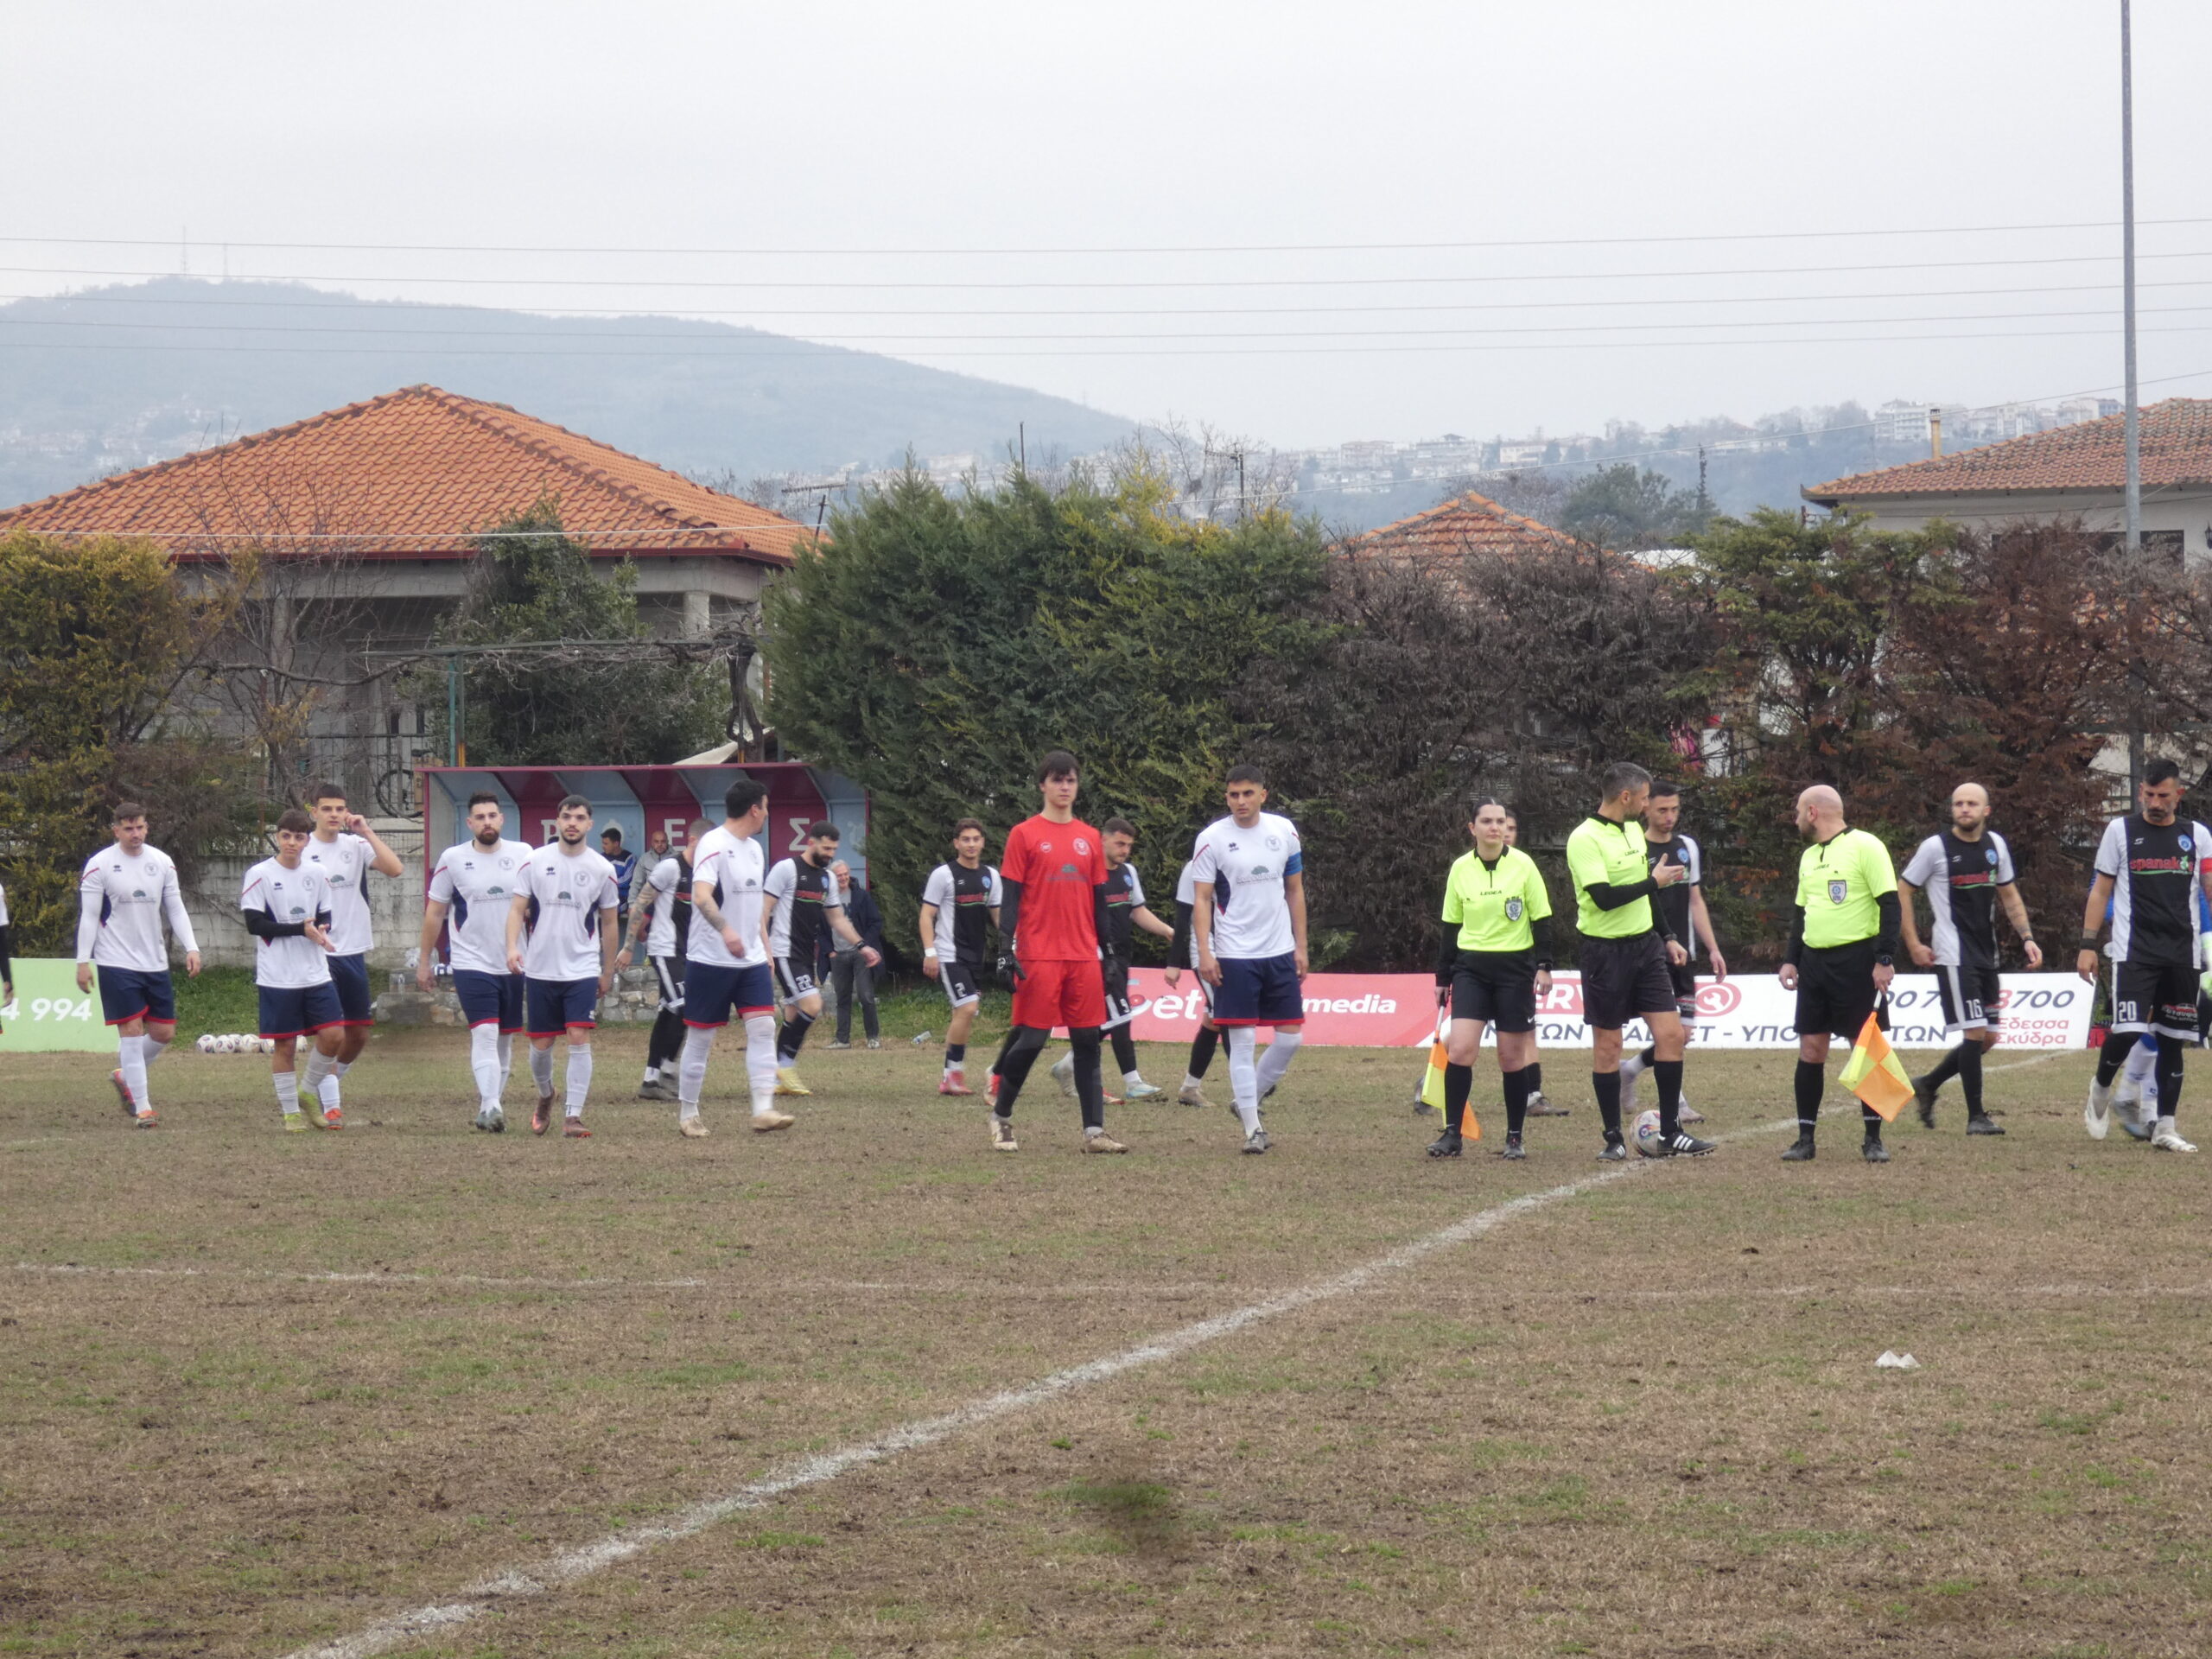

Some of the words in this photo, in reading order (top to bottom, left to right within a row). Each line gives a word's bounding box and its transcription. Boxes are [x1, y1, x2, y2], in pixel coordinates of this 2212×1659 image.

[31, 997, 92, 1021] 994
[1301, 994, 1396, 1014] media
[1967, 999, 1983, 1019] 16
[2119, 1001, 2137, 1022] 20
